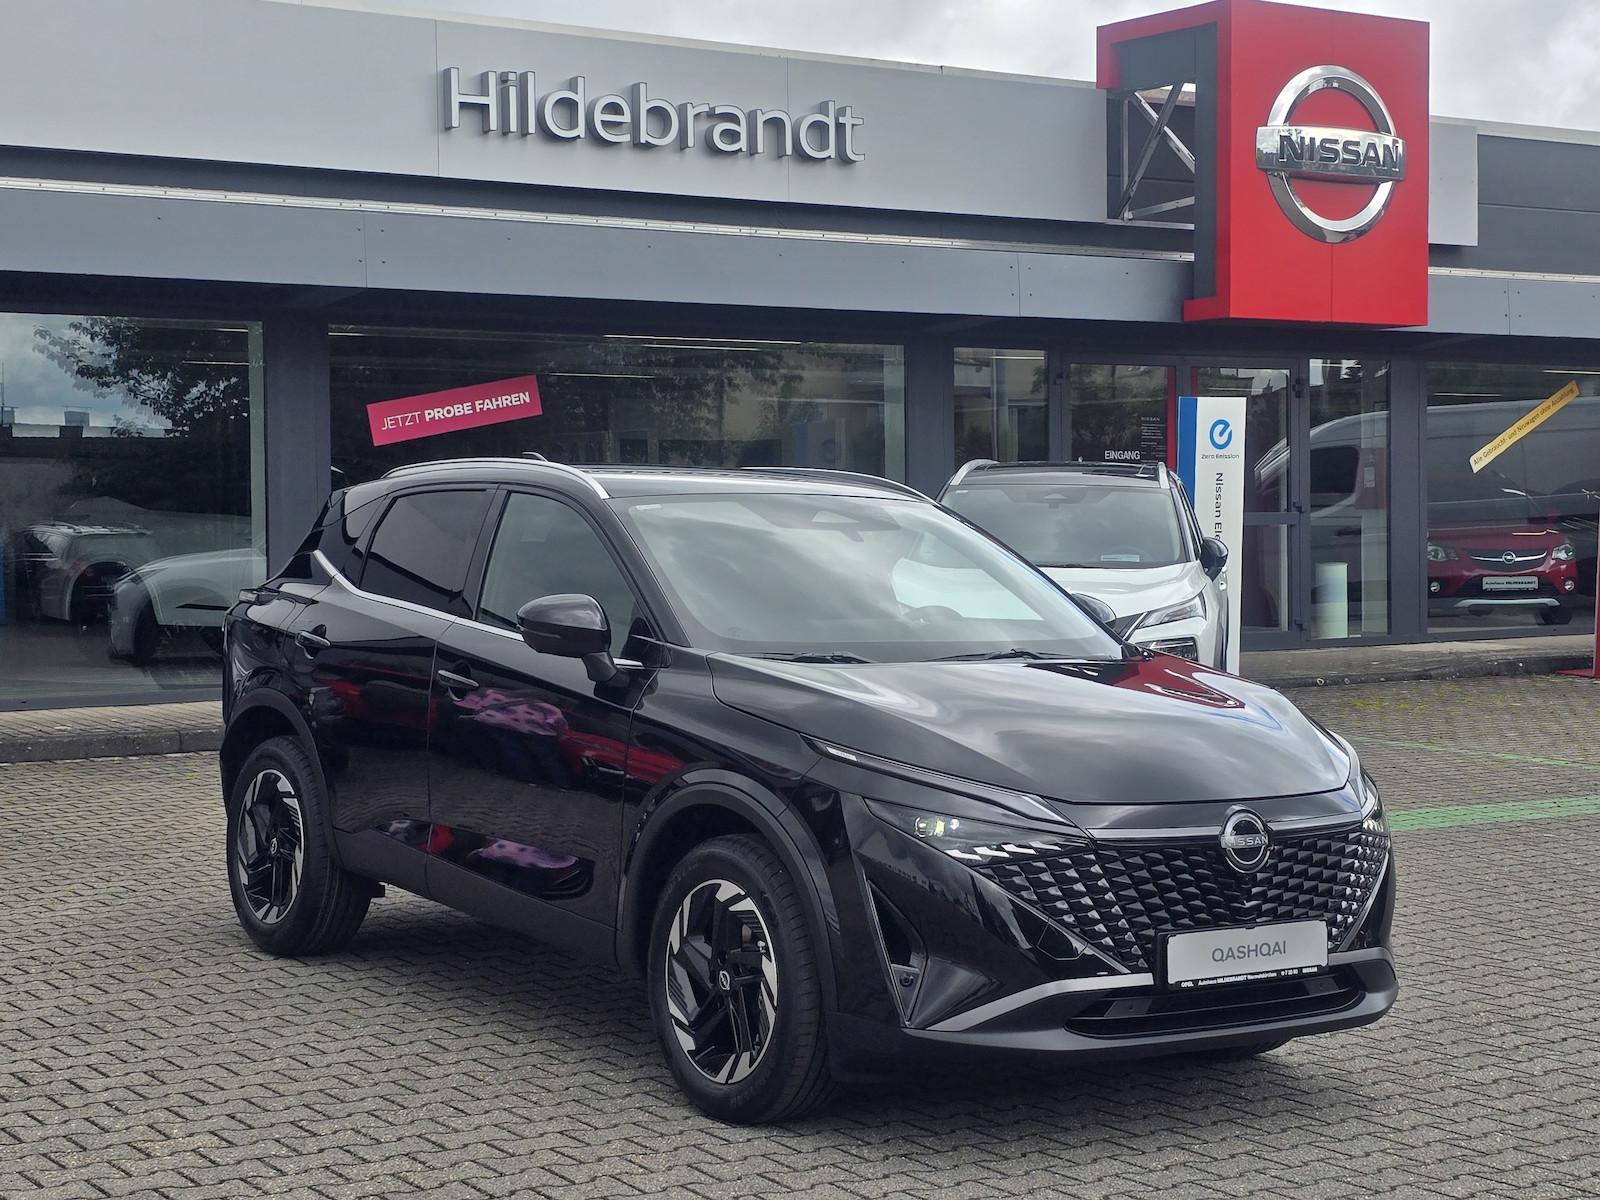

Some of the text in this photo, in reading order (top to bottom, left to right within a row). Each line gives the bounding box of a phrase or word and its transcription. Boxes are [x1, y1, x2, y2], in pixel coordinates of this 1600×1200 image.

[442, 66, 866, 164] Hildebrandt
[1278, 134, 1400, 172] NISSAN
[381, 391, 531, 431] JETZT PROBE FAHREN
[1104, 450, 1141, 460] EINGANG
[1214, 472, 1224, 519] Nissan
[1222, 835, 1269, 847] NISSAN
[1211, 940, 1287, 964] QASHQAI
